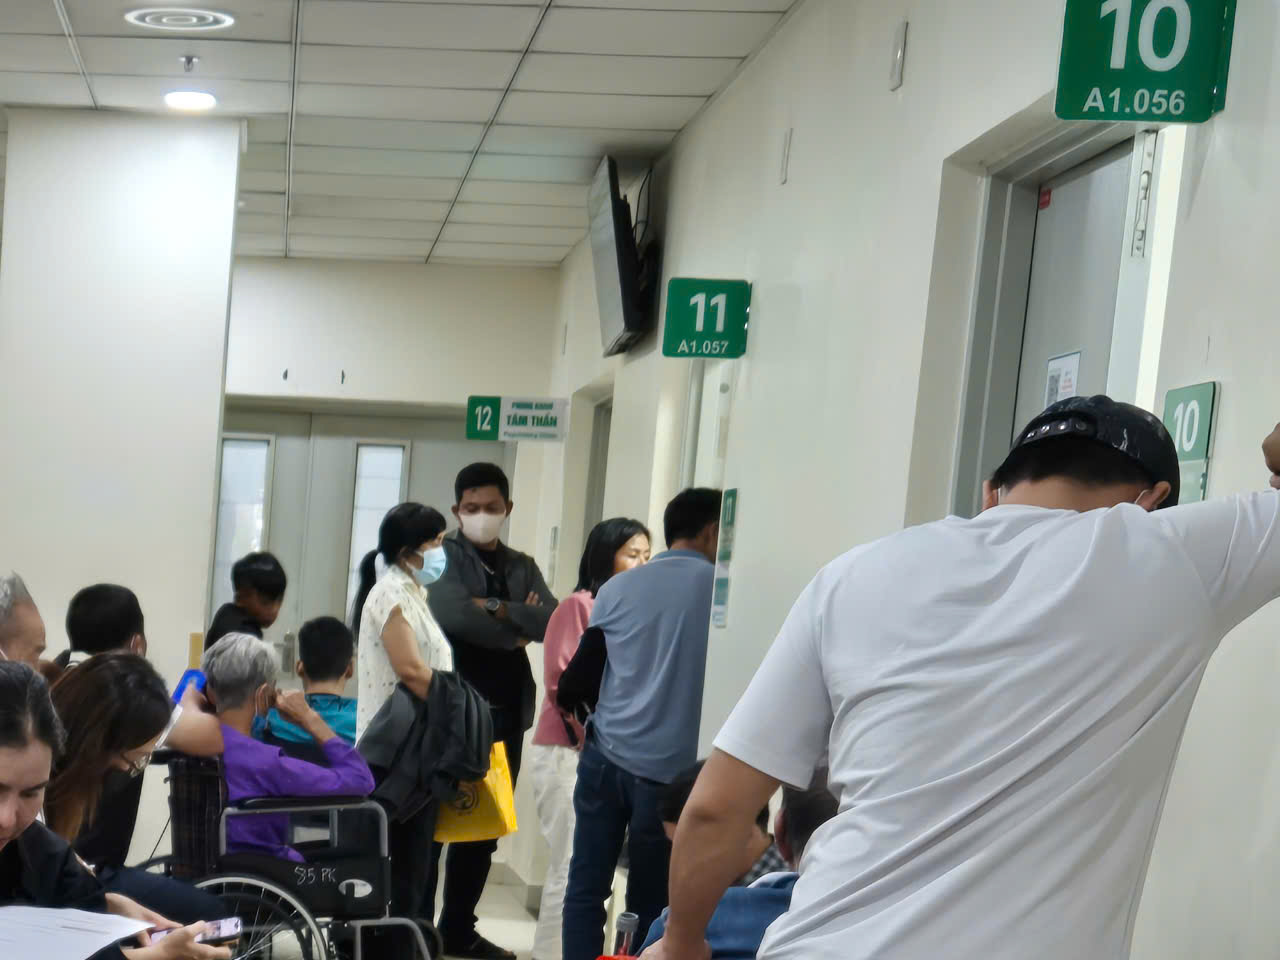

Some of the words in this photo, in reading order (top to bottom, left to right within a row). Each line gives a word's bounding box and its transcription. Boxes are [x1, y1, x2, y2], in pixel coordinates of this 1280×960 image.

[1099, 0, 1192, 72] 10
[1082, 87, 1186, 115] A1.056
[689, 292, 727, 332] 11
[677, 339, 729, 354] A1.057
[475, 405, 492, 431] 12
[1173, 399, 1200, 452] 10
